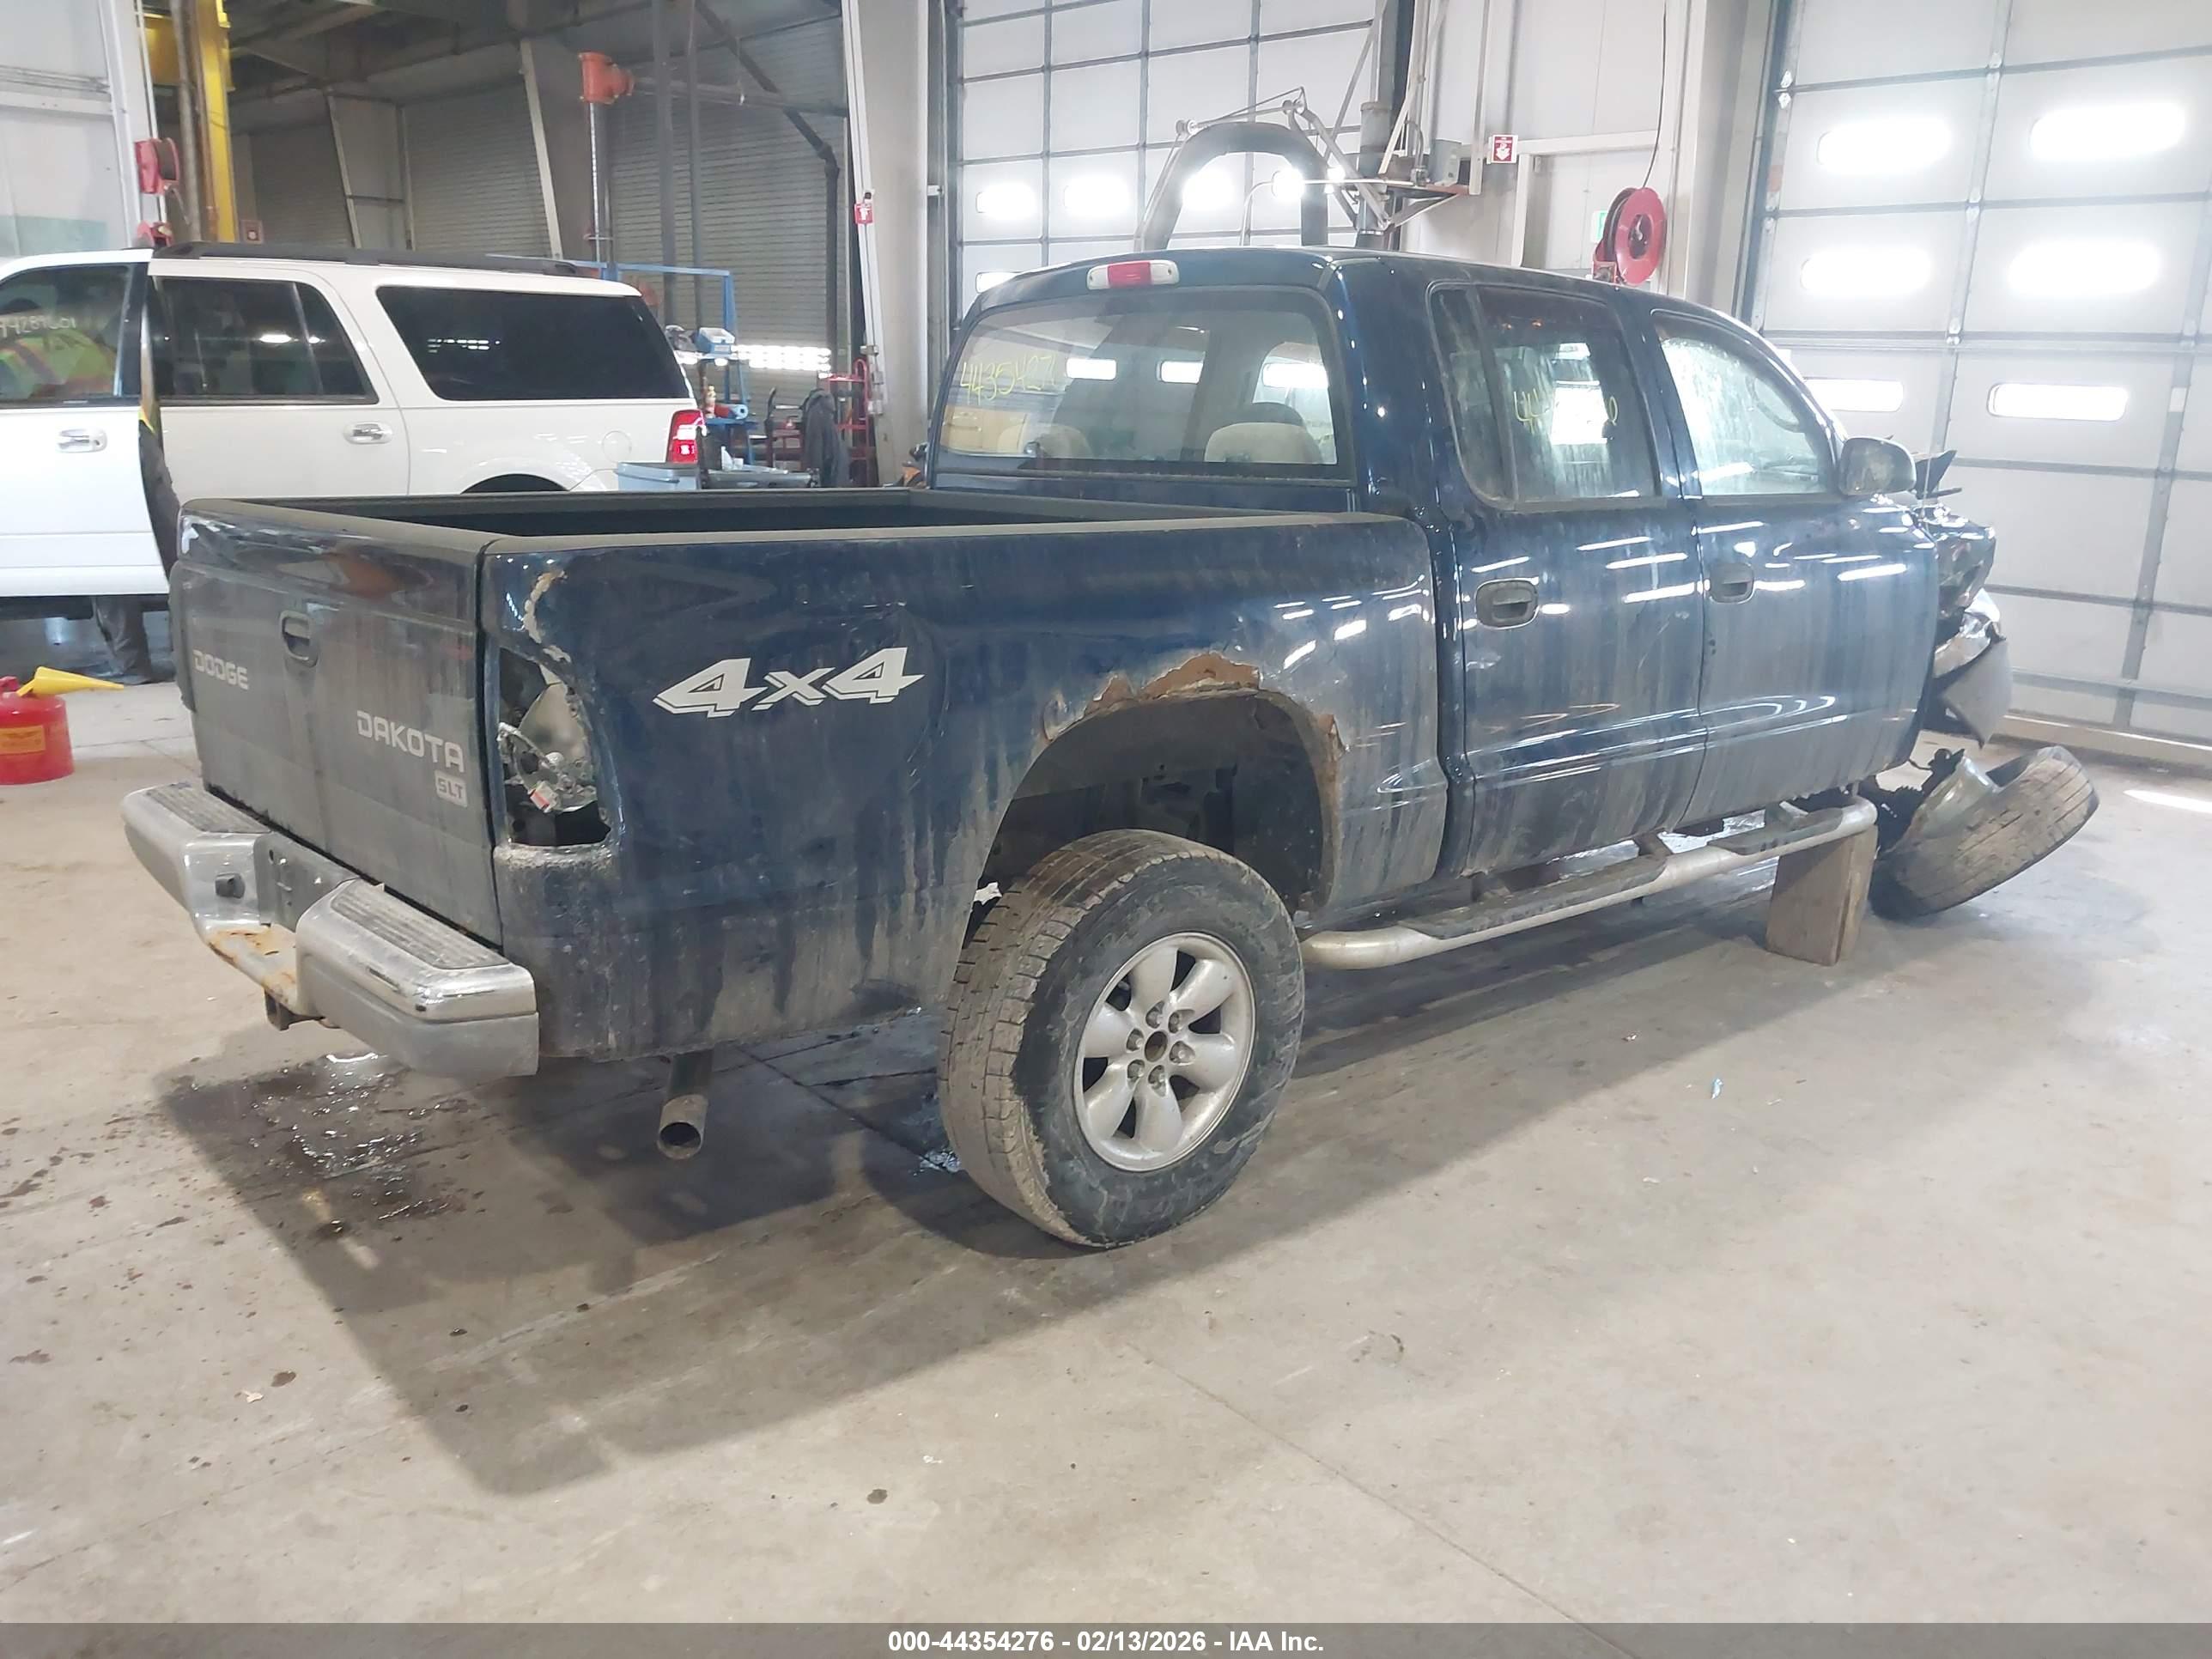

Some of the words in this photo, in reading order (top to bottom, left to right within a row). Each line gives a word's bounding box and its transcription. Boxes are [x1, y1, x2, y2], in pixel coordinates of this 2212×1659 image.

[191, 648, 249, 690] DODGE
[652, 647, 926, 719] 4x4
[356, 709, 465, 773] DAKOTA
[437, 776, 464, 799] SLT
